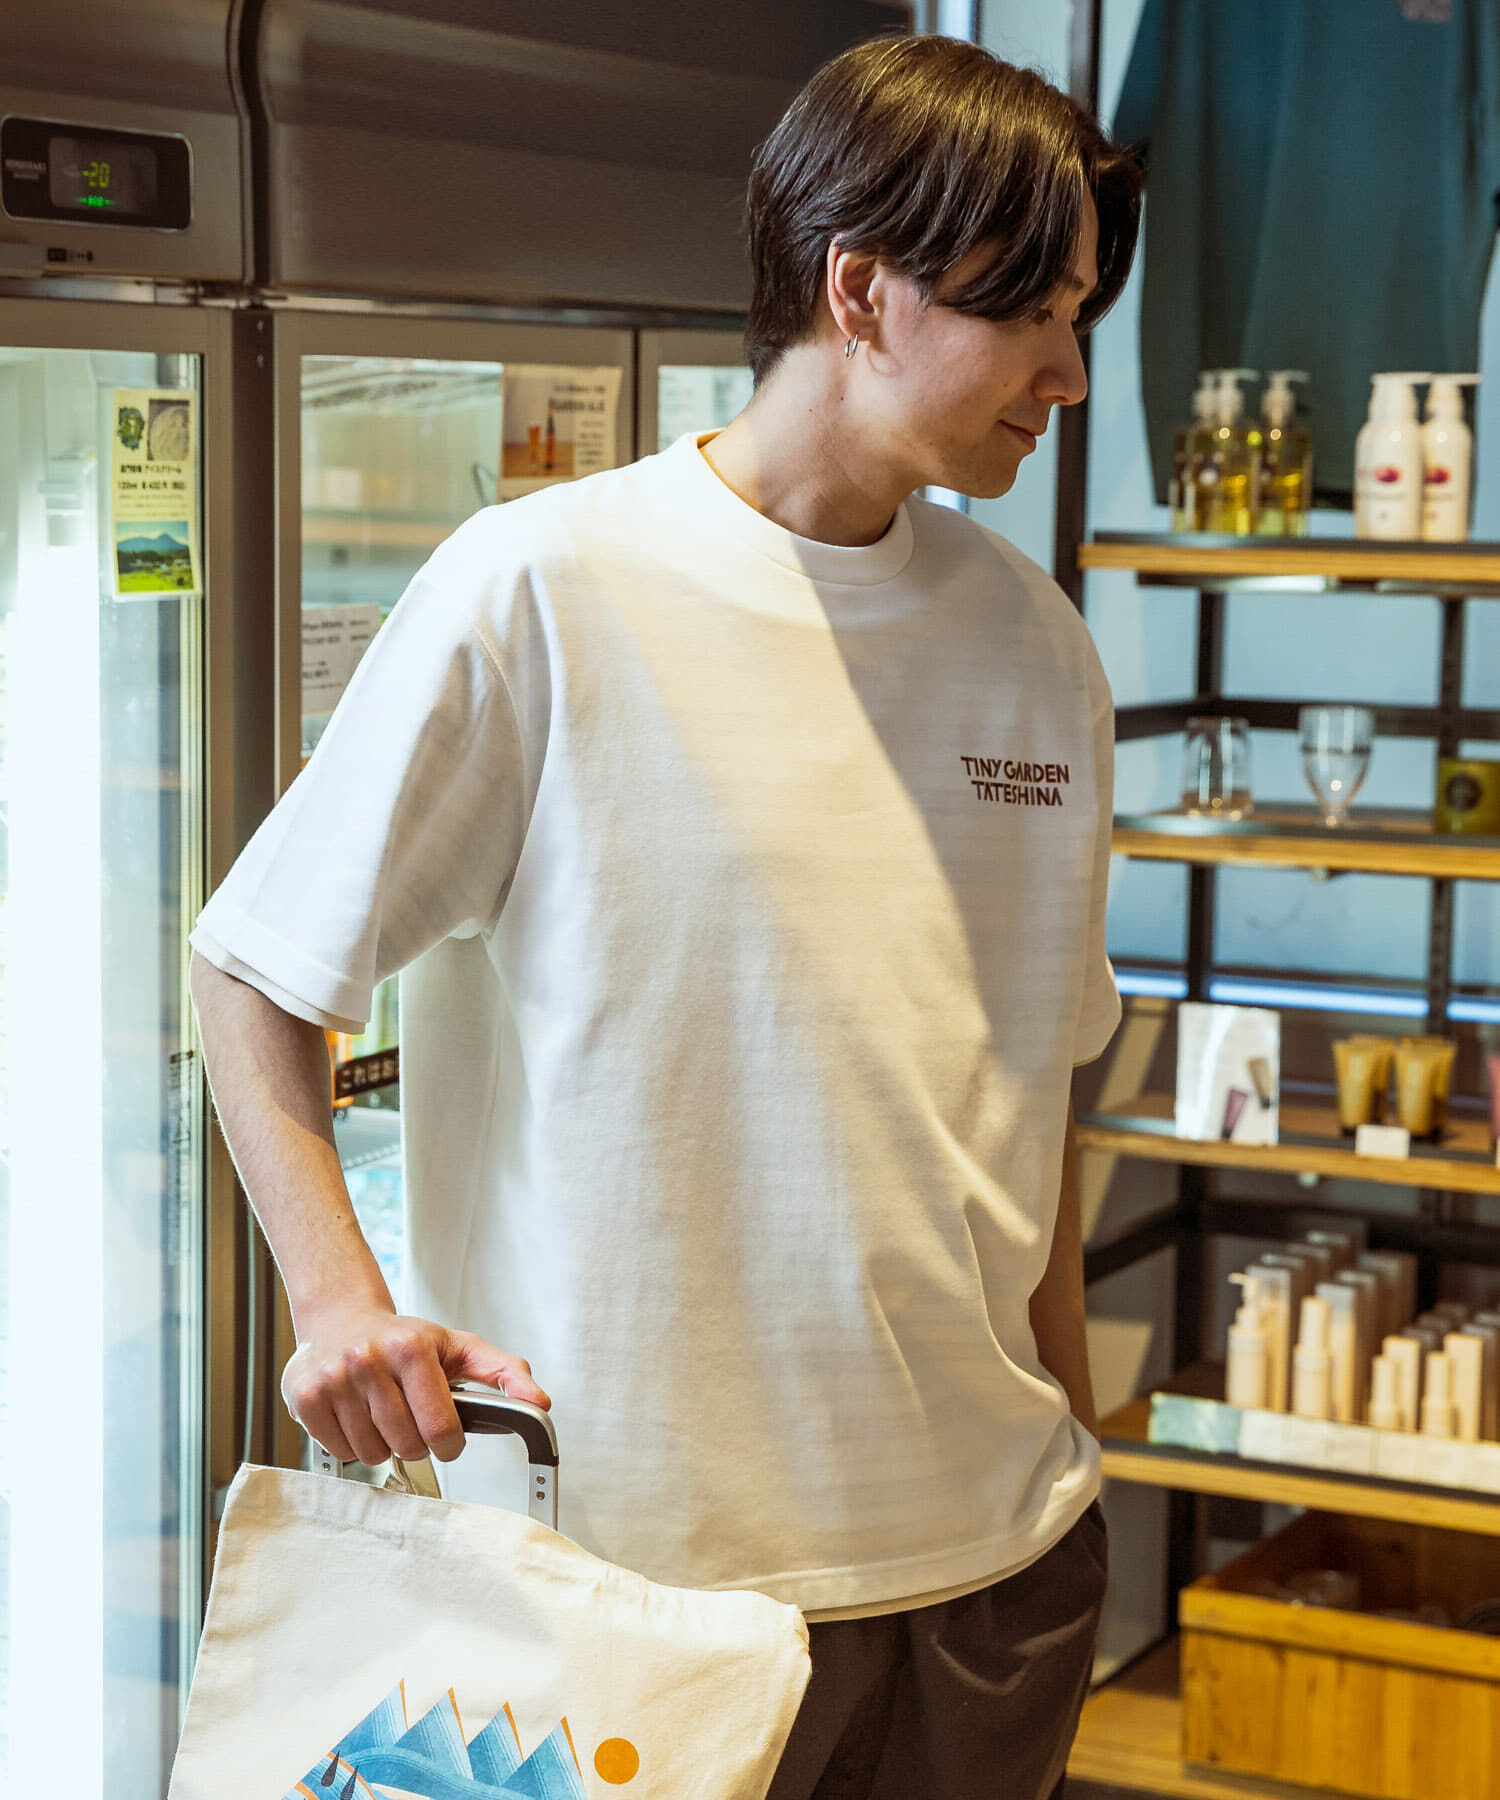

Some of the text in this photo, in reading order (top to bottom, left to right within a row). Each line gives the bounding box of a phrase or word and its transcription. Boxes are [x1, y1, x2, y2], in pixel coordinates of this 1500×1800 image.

[960, 756, 1070, 784] TINY GARDEN
[971, 780, 1063, 806] TATESHINA
